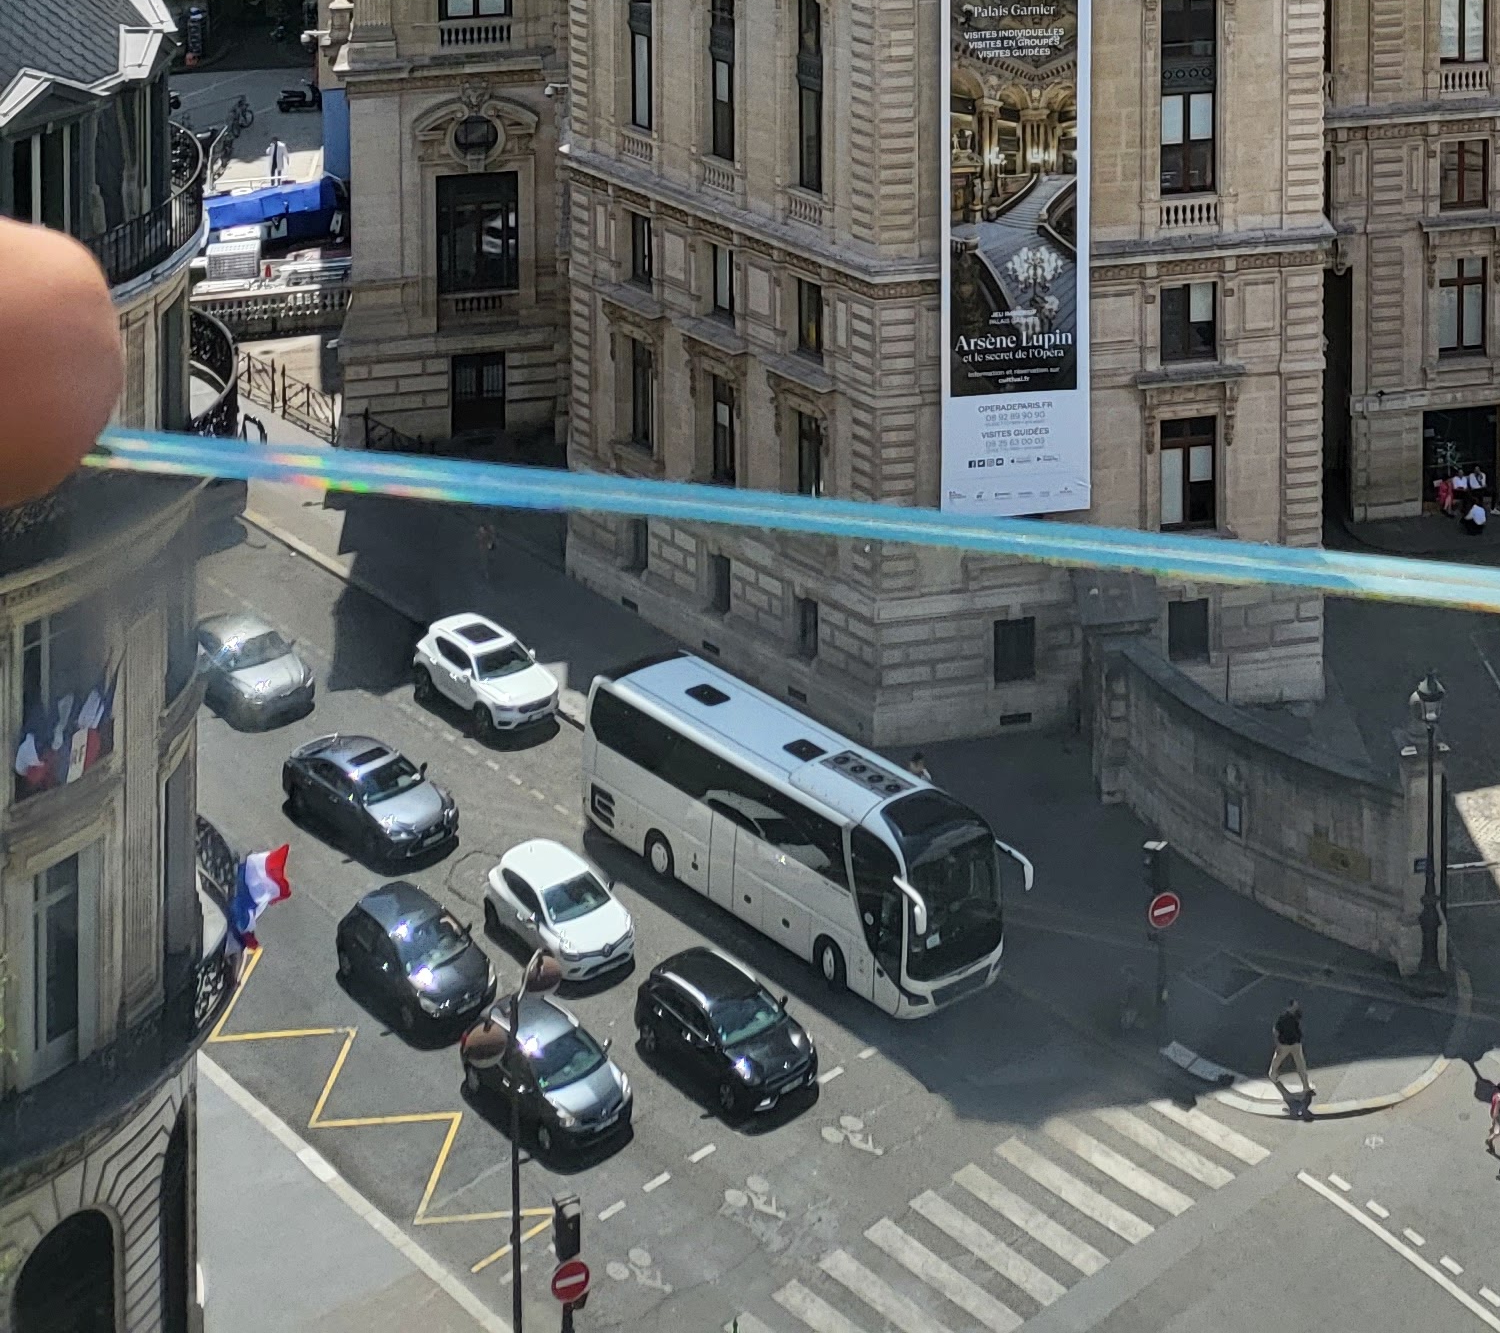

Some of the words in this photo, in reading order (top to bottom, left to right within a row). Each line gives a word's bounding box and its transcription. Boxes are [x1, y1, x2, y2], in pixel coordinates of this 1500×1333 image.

[974, 4, 1010, 17] Palais
[1011, 3, 1056, 16] Garnier
[964, 31, 998, 40] VISITES
[999, 28, 1065, 38] INDIVIDUELLES
[968, 40, 1002, 49] VISITES
[1004, 40, 1016, 48] EN
[1018, 37, 1060, 47] GROUPES
[978, 49, 1011, 59] VISITES
[1012, 47, 1051, 57] GUIDÉES
[955, 334, 1017, 352] Arsène
[1021, 330, 1073, 349] Lupin
[962, 354, 973, 363] et
[974, 352, 984, 362] le
[985, 351, 1014, 361] secret
[1015, 349, 1028, 359] de
[981, 430, 1012, 439] VISITES
